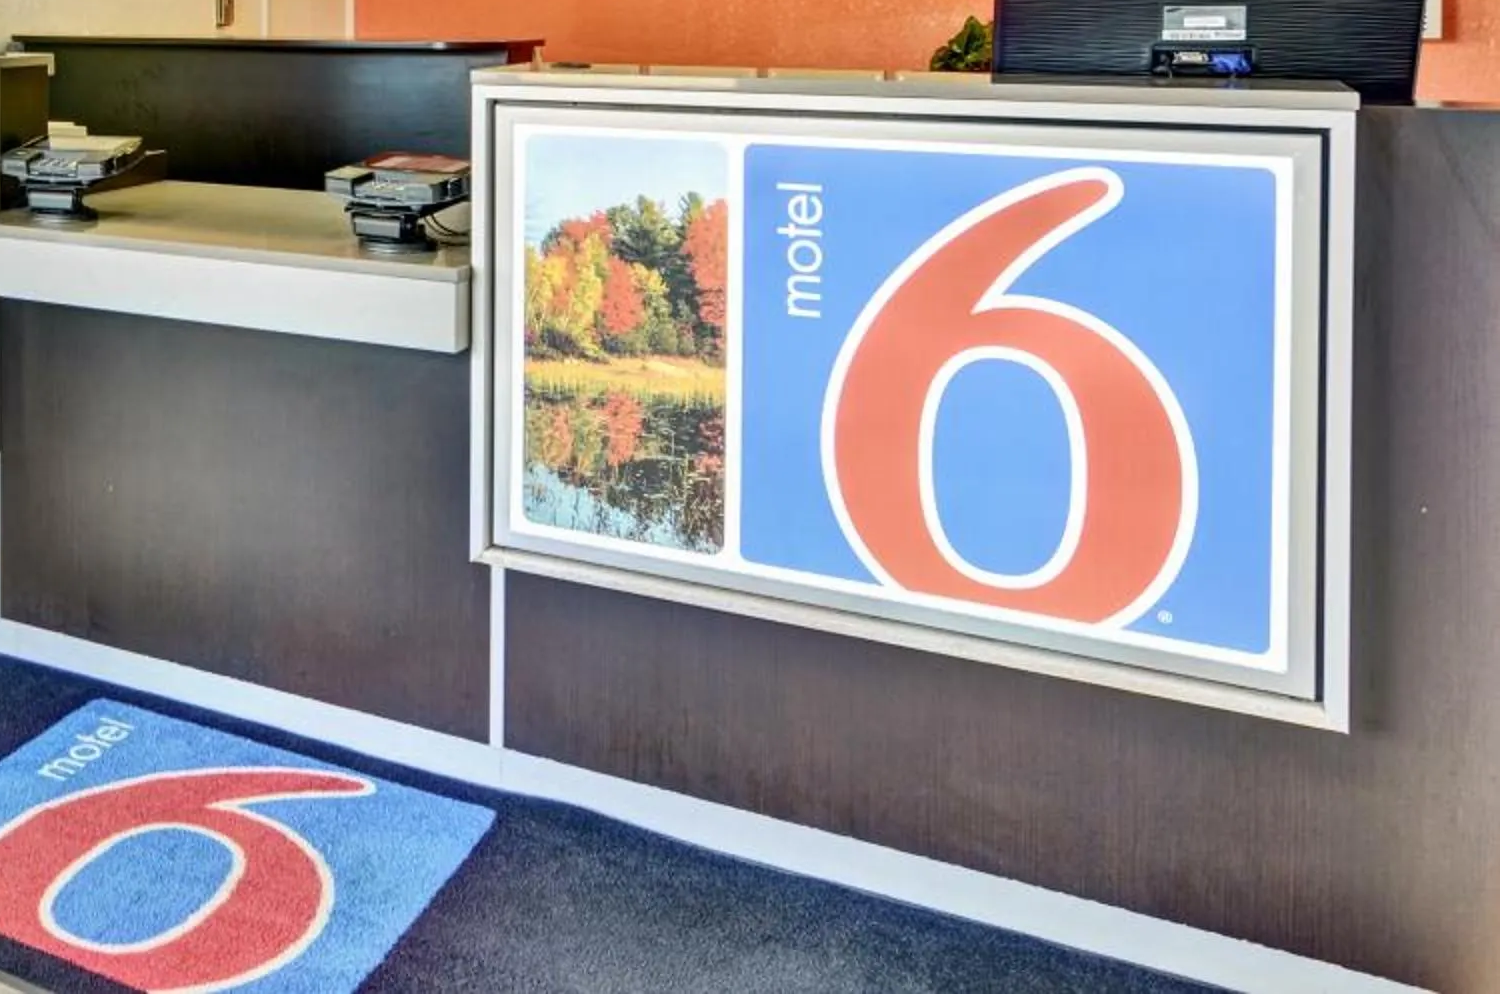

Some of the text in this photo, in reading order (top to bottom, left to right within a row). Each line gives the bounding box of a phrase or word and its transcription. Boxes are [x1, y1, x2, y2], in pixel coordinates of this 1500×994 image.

[776, 167, 1198, 633] motel 6
[38, 718, 134, 781] motel
